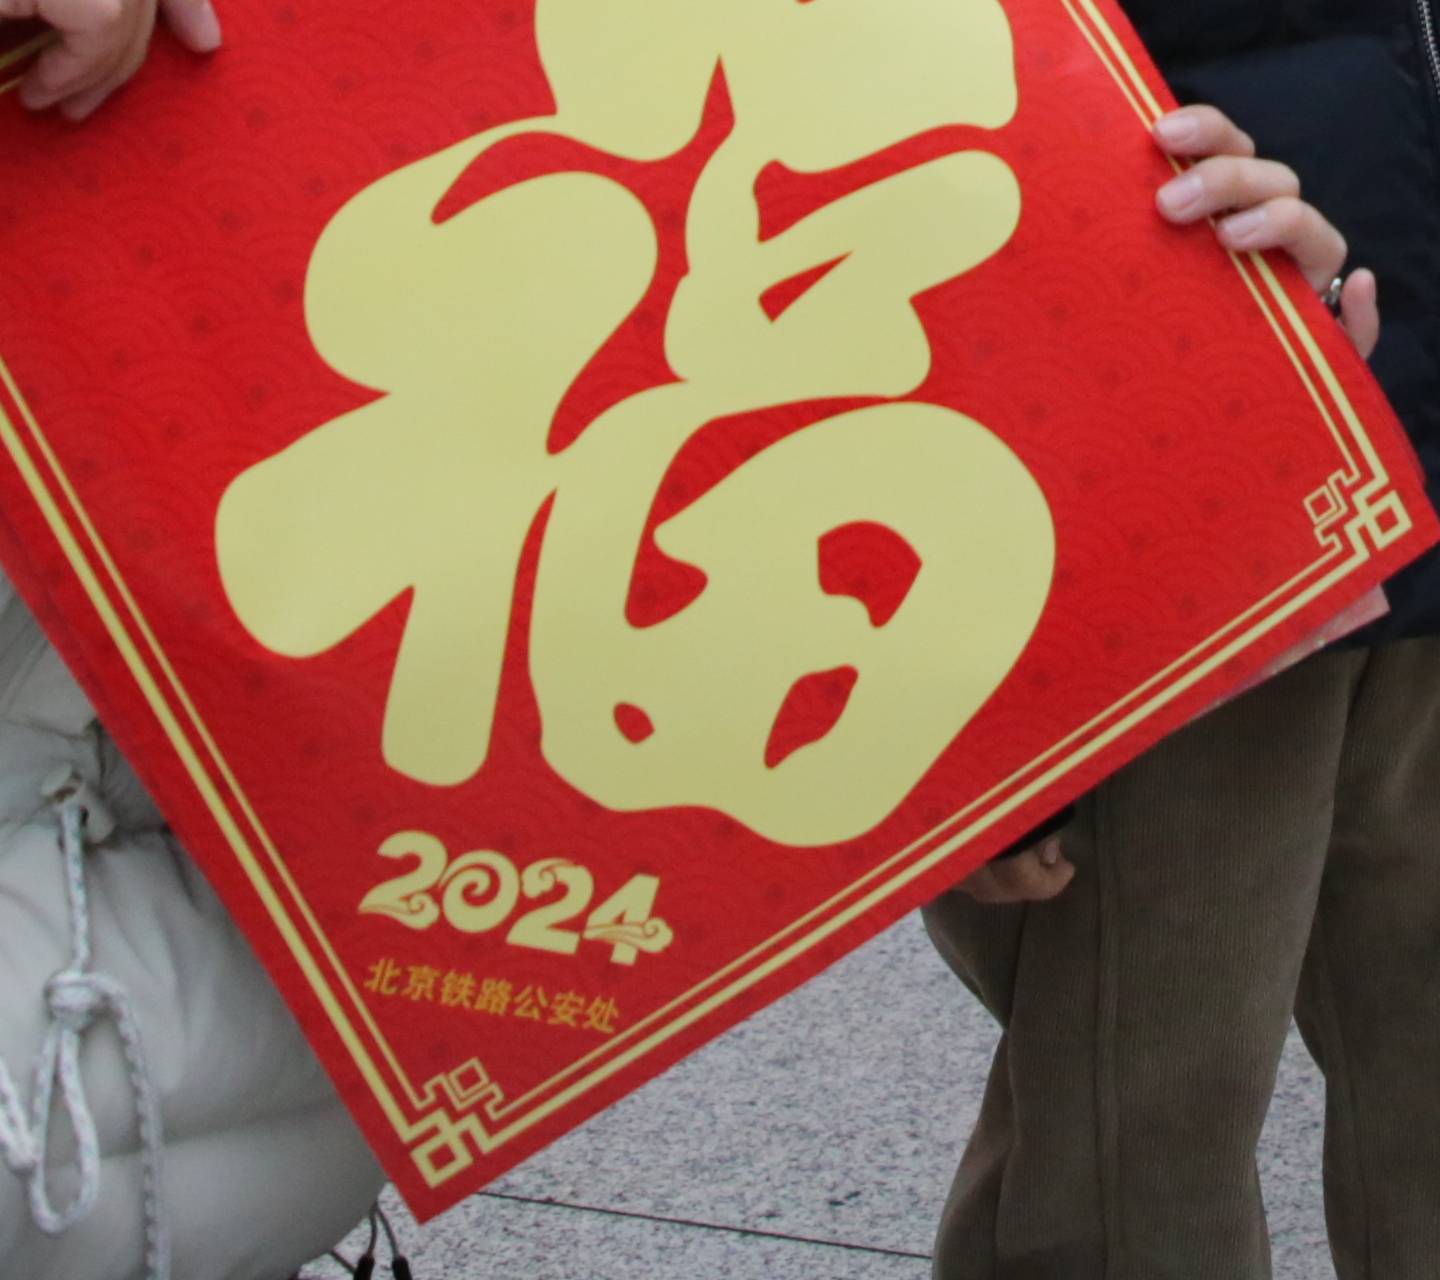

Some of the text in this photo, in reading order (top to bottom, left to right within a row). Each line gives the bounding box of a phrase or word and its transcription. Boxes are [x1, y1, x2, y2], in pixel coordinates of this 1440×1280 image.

[358, 829, 674, 966] 2024
[363, 958, 619, 1034] 北京铁路公安处
